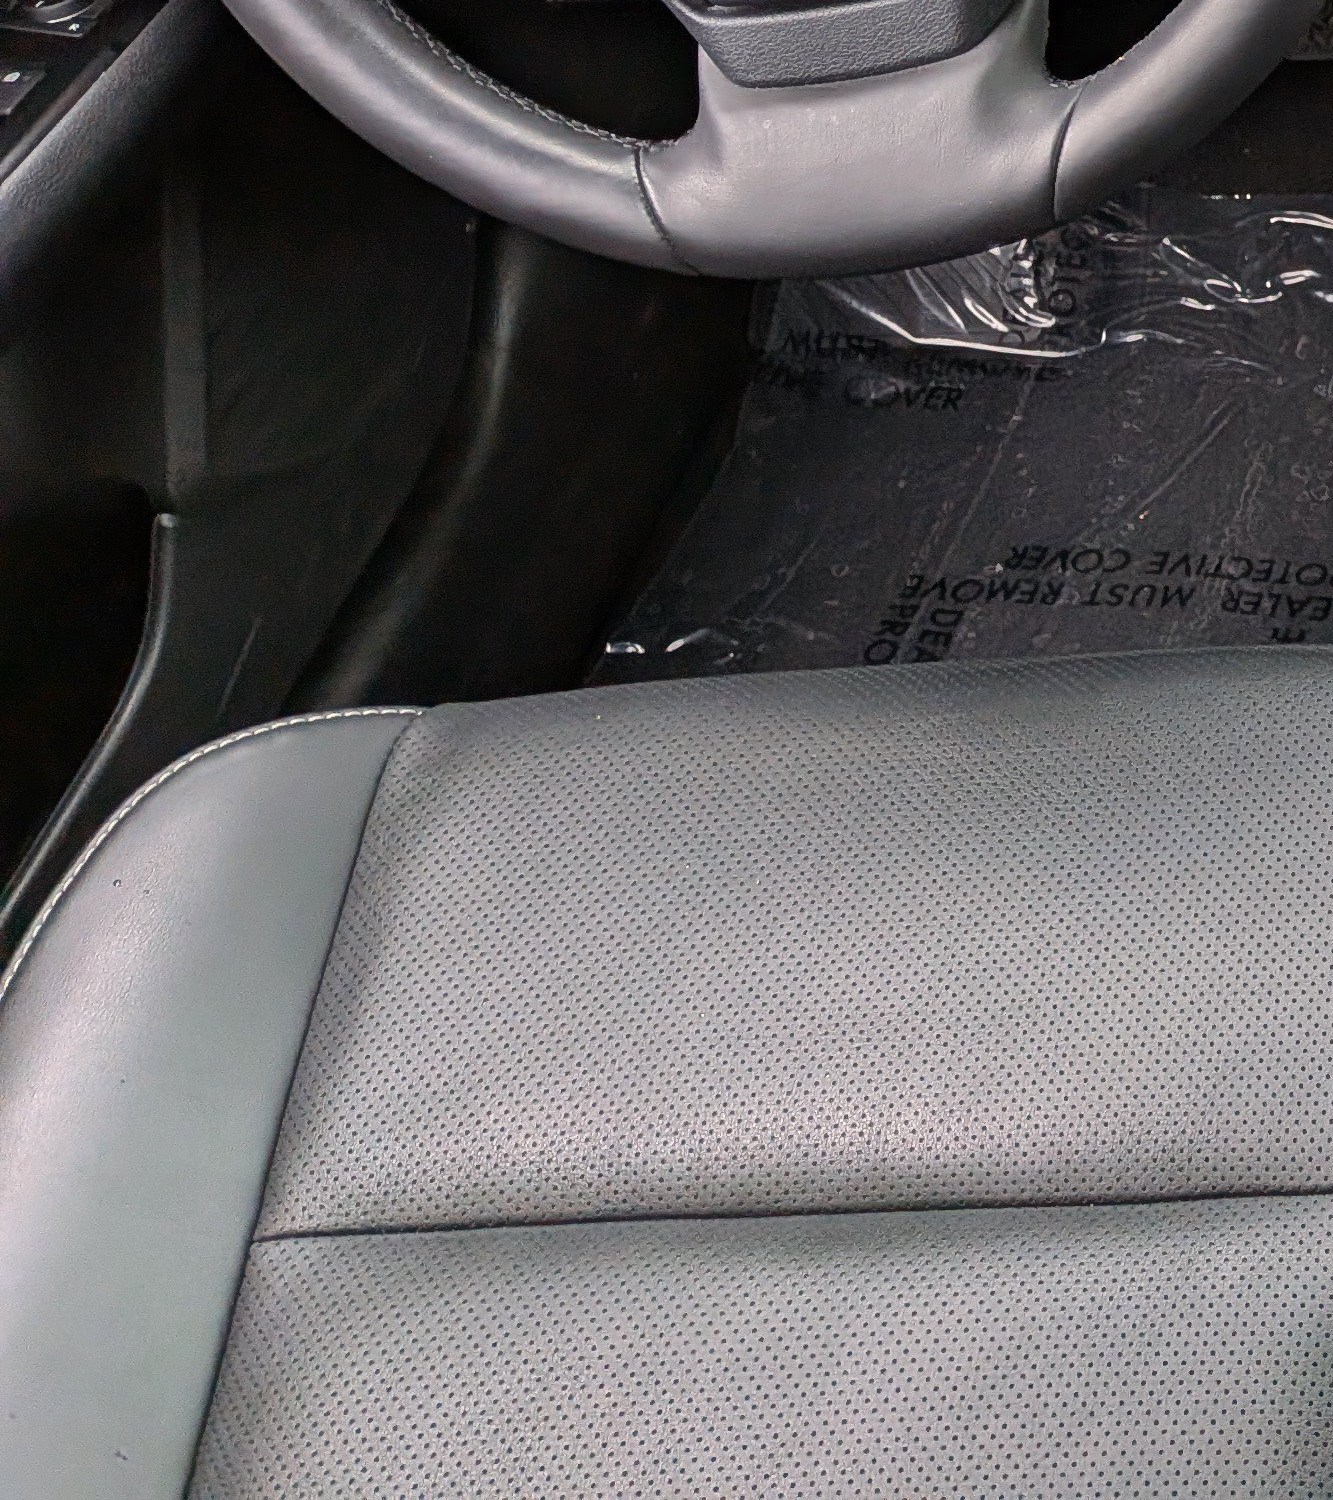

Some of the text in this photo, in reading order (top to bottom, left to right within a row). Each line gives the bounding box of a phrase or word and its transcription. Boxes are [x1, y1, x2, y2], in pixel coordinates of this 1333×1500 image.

[1005, 545, 1132, 573] COVER
[898, 573, 1064, 606] REMOVE
[1080, 579, 1196, 610] MUST
